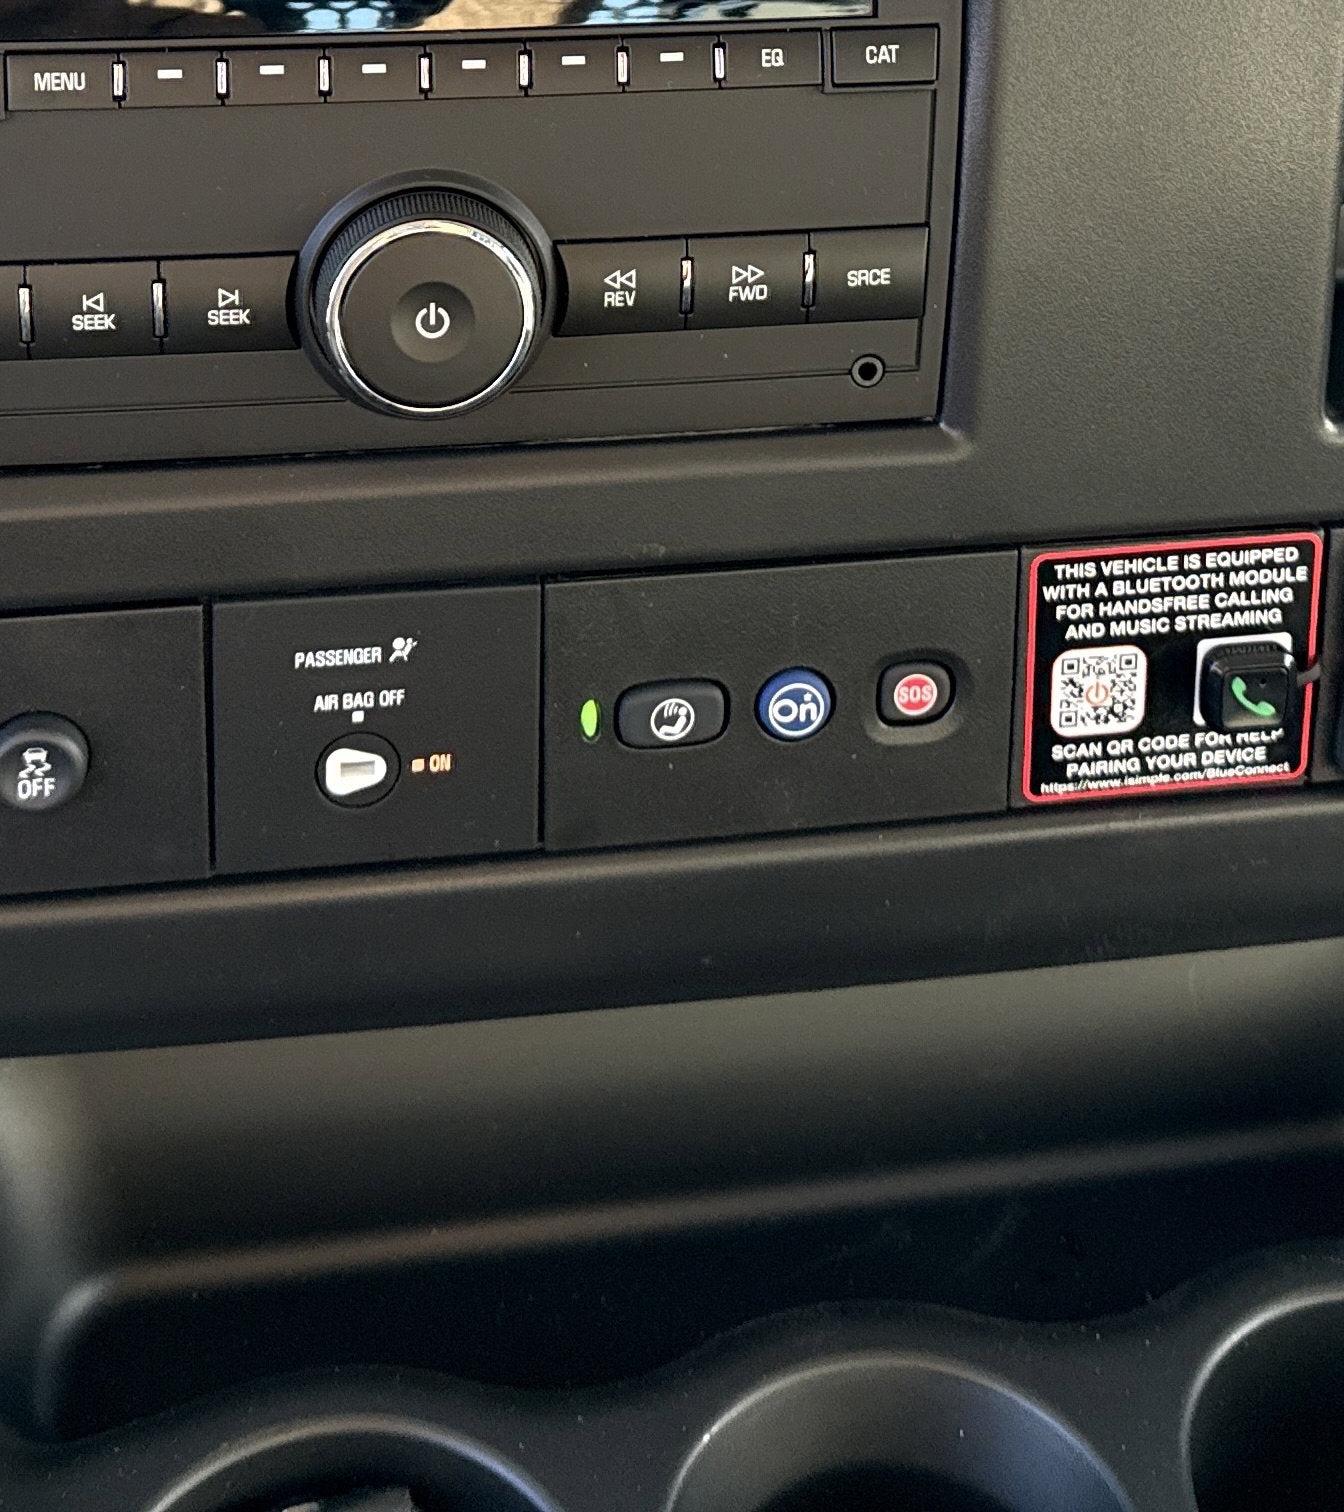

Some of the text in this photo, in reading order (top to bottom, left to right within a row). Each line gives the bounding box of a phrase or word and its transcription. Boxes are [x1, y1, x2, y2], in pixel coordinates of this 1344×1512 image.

[761, 48, 785, 67] EQ
[865, 44, 900, 65] CAT
[33, 72, 86, 92] MENU
[846, 268, 892, 287] SRCE
[604, 290, 636, 308] REV
[728, 284, 768, 303] FWD
[71, 314, 117, 331] SEEK
[207, 308, 251, 326] SEEK
[1054, 546, 1299, 580] THIS VEHICLE IS EQUIPPED
[1042, 565, 1308, 603] WITH A BLUETOOTH MODULE
[1056, 587, 1294, 622] FOR HANDSFREE CALLING
[1065, 607, 1283, 640] AND MUSIC STREAMING
[294, 646, 383, 669] PASSENGER
[313, 688, 406, 712] AIR BAG OFF
[897, 684, 933, 704] SOS
[1052, 740, 1103, 761] SCAN
[1106, 738, 1133, 756] QR
[1137, 733, 1190, 754] CODE
[429, 753, 452, 773] ON
[1066, 745, 1267, 779] PAIRING YOUR DEVICE
[17, 777, 56, 800] OFF
